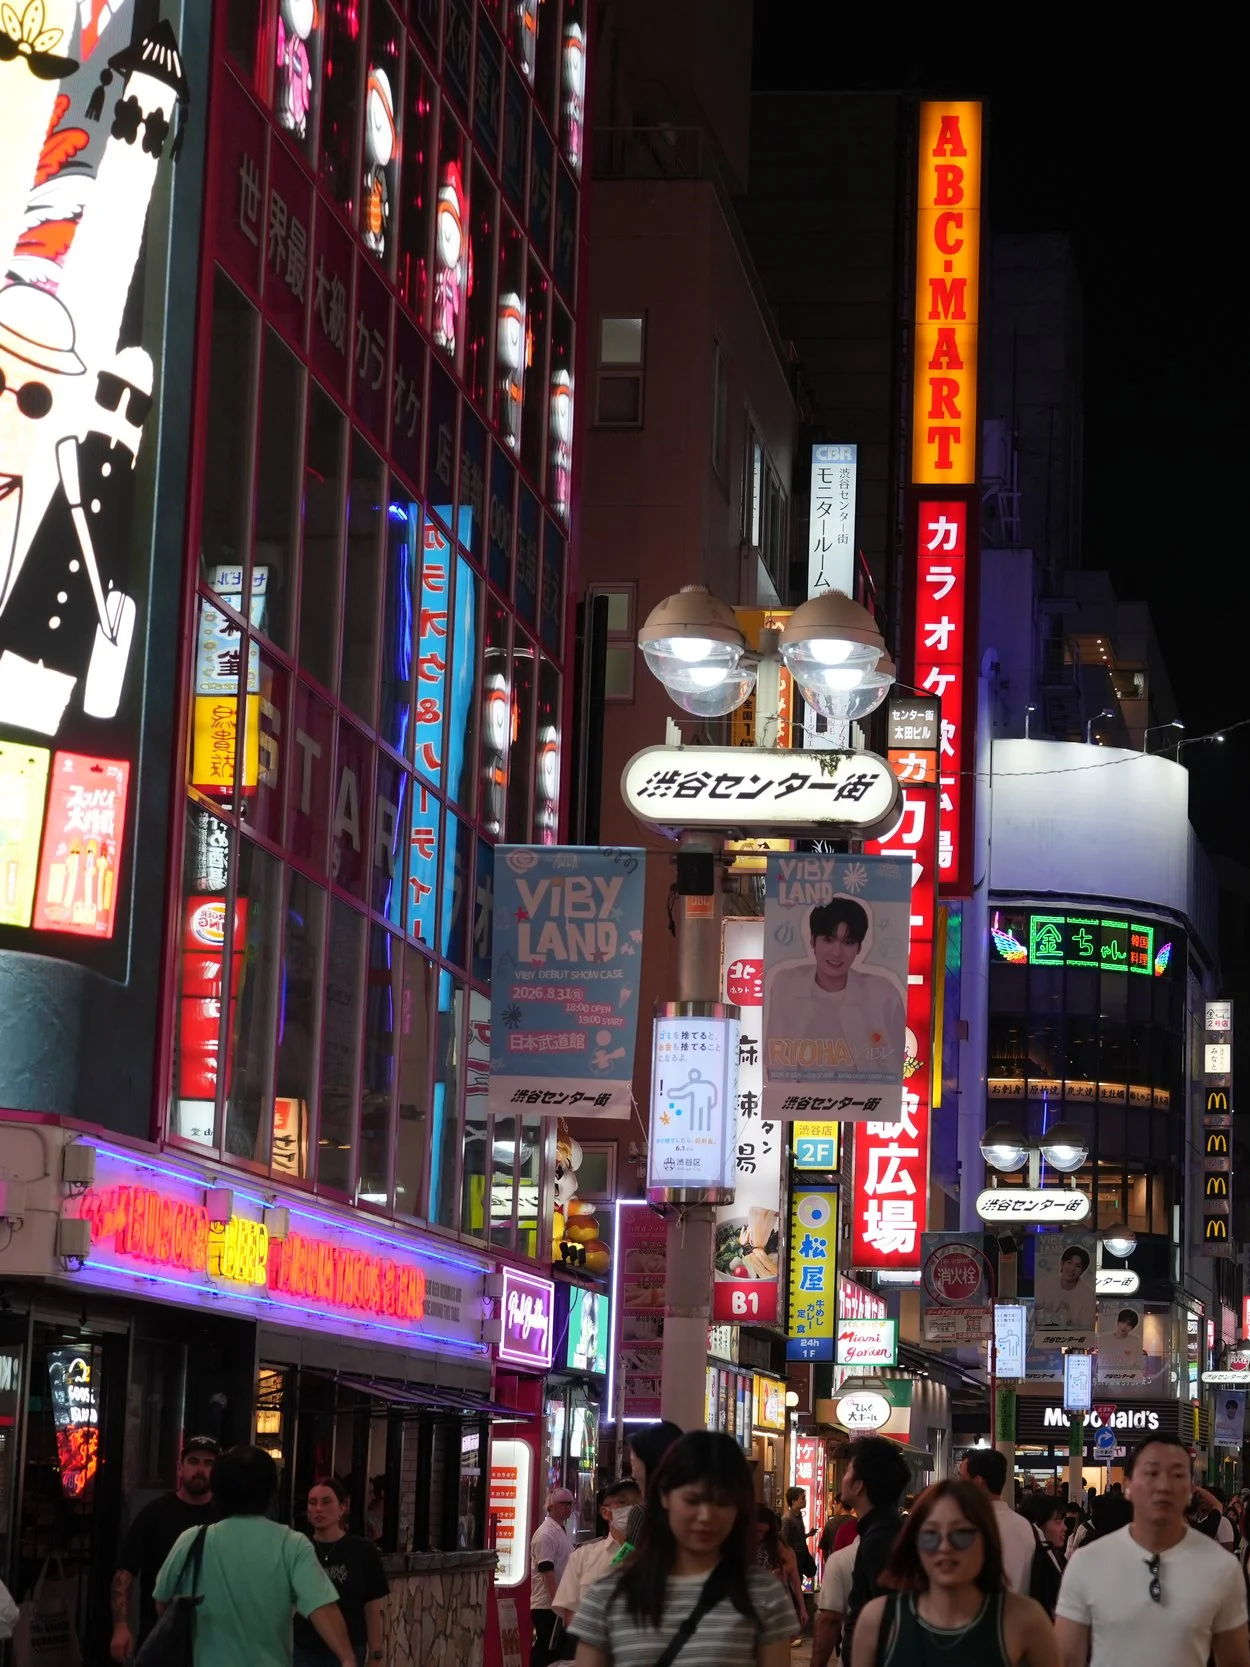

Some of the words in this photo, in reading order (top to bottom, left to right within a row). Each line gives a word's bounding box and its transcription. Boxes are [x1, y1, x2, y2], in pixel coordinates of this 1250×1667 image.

[816, 446, 852, 461] CBR
[837, 468, 851, 545] 渋谷センター街
[813, 466, 834, 588] モニタールーム
[894, 725, 932, 740] 太田ビル
[637, 771, 879, 802] 渋谷センター街
[1036, 923, 1127, 961] 金ちゃん
[538, 969, 569, 980] DEBUT
[600, 969, 624, 980] CASE
[510, 1034, 585, 1050] 日本武道館
[768, 1039, 853, 1067] RYOHA
[511, 1089, 612, 1107] 渋谷センター街
[781, 1096, 882, 1112] 渋谷センター街
[761, 1121, 775, 1156] タン
[800, 1125, 833, 1136] 渋谷店
[802, 1143, 830, 1162] 2F
[981, 1198, 1084, 1213] 渋谷センター街
[799, 1233, 829, 1292] 松屋
[938, 1266, 976, 1285] 消火栓
[731, 1291, 759, 1315] B1
[800, 1339, 820, 1347] 24h
[803, 1350, 816, 1358] 1F
